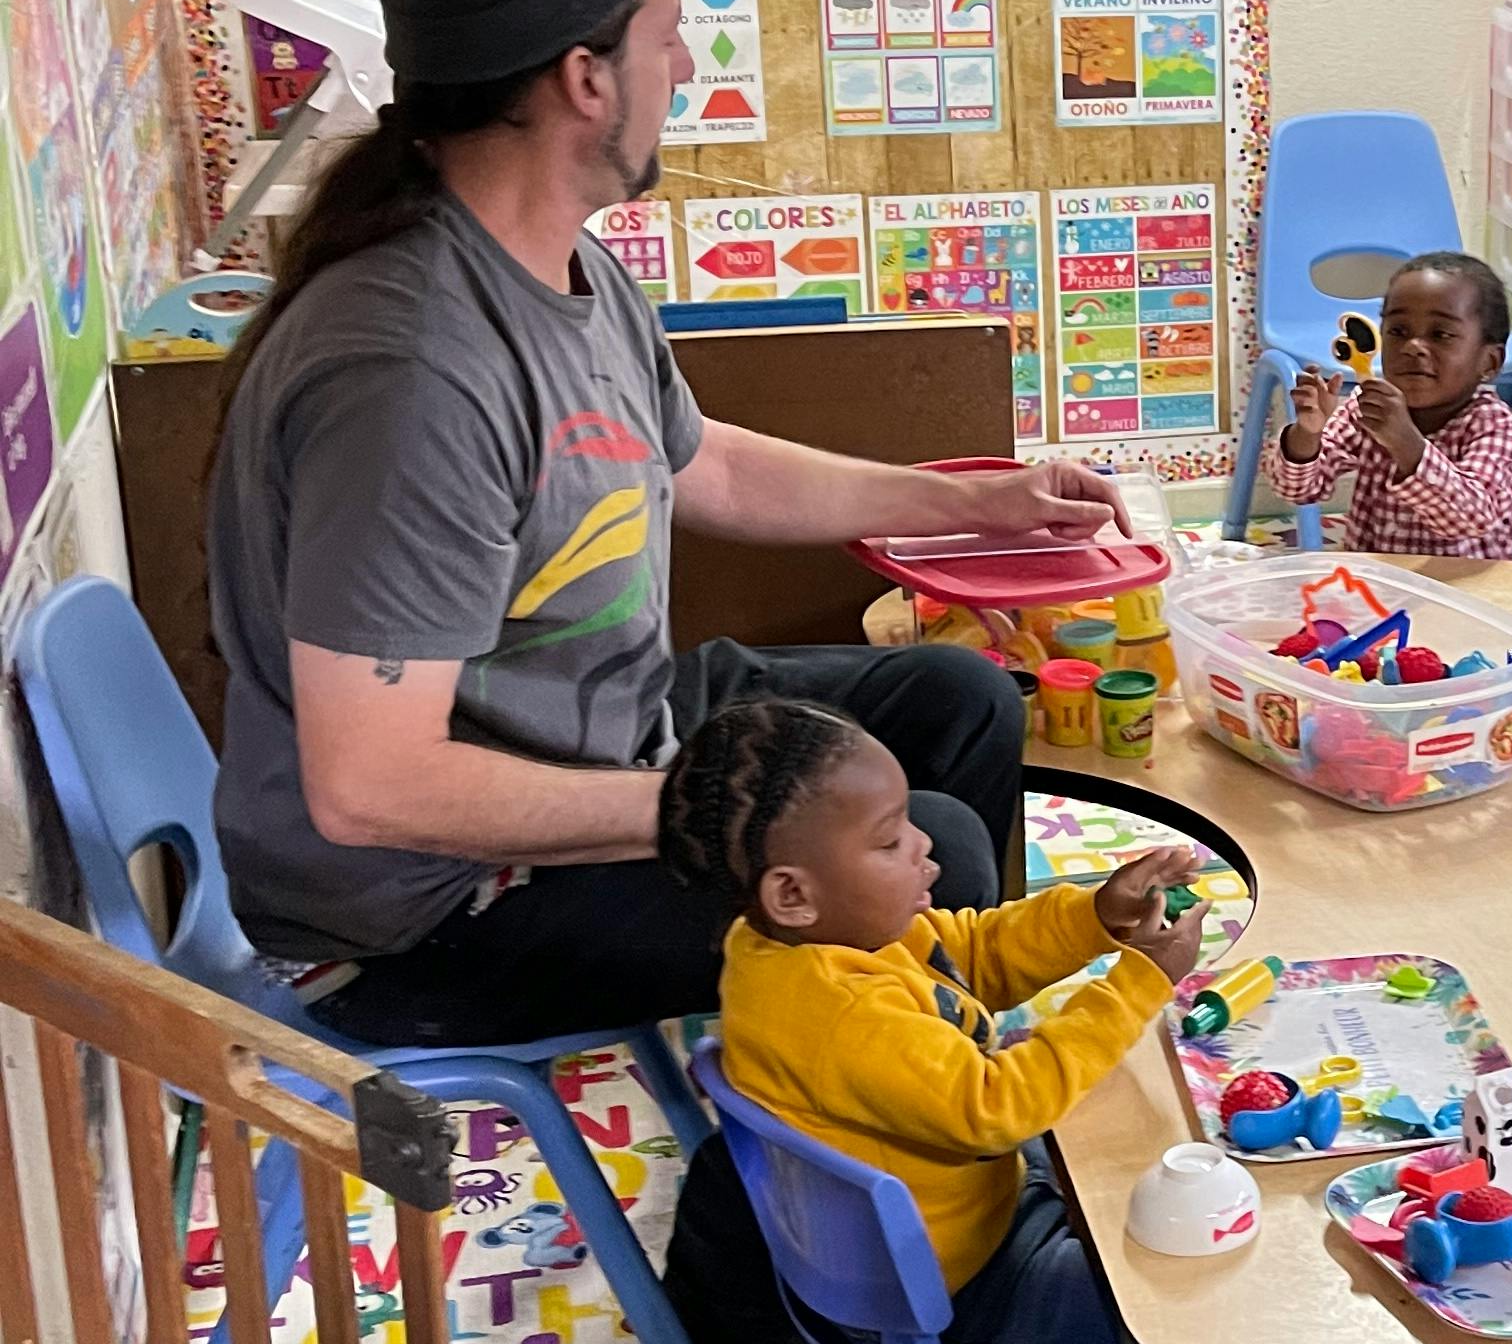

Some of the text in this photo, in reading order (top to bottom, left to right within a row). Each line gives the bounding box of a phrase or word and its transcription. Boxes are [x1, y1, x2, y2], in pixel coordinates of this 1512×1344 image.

[1070, 100, 1128, 117] OTOÑO
[1145, 99, 1214, 112] PRIMAVERA
[884, 199, 1026, 222] EL ALPHABETO
[1057, 198, 1090, 215] LOS
[1095, 195, 1150, 214] MESES
[1171, 191, 1210, 210] AÑO
[716, 206, 835, 232] COLORES
[1091, 238, 1131, 251] ENERO
[1175, 236, 1210, 248] JULIO
[1078, 274, 1134, 288] FEBRERO
[1161, 269, 1212, 285] AGOSTO
[1101, 419, 1137, 432] JUNIO
[459, 1268, 542, 1327] T
